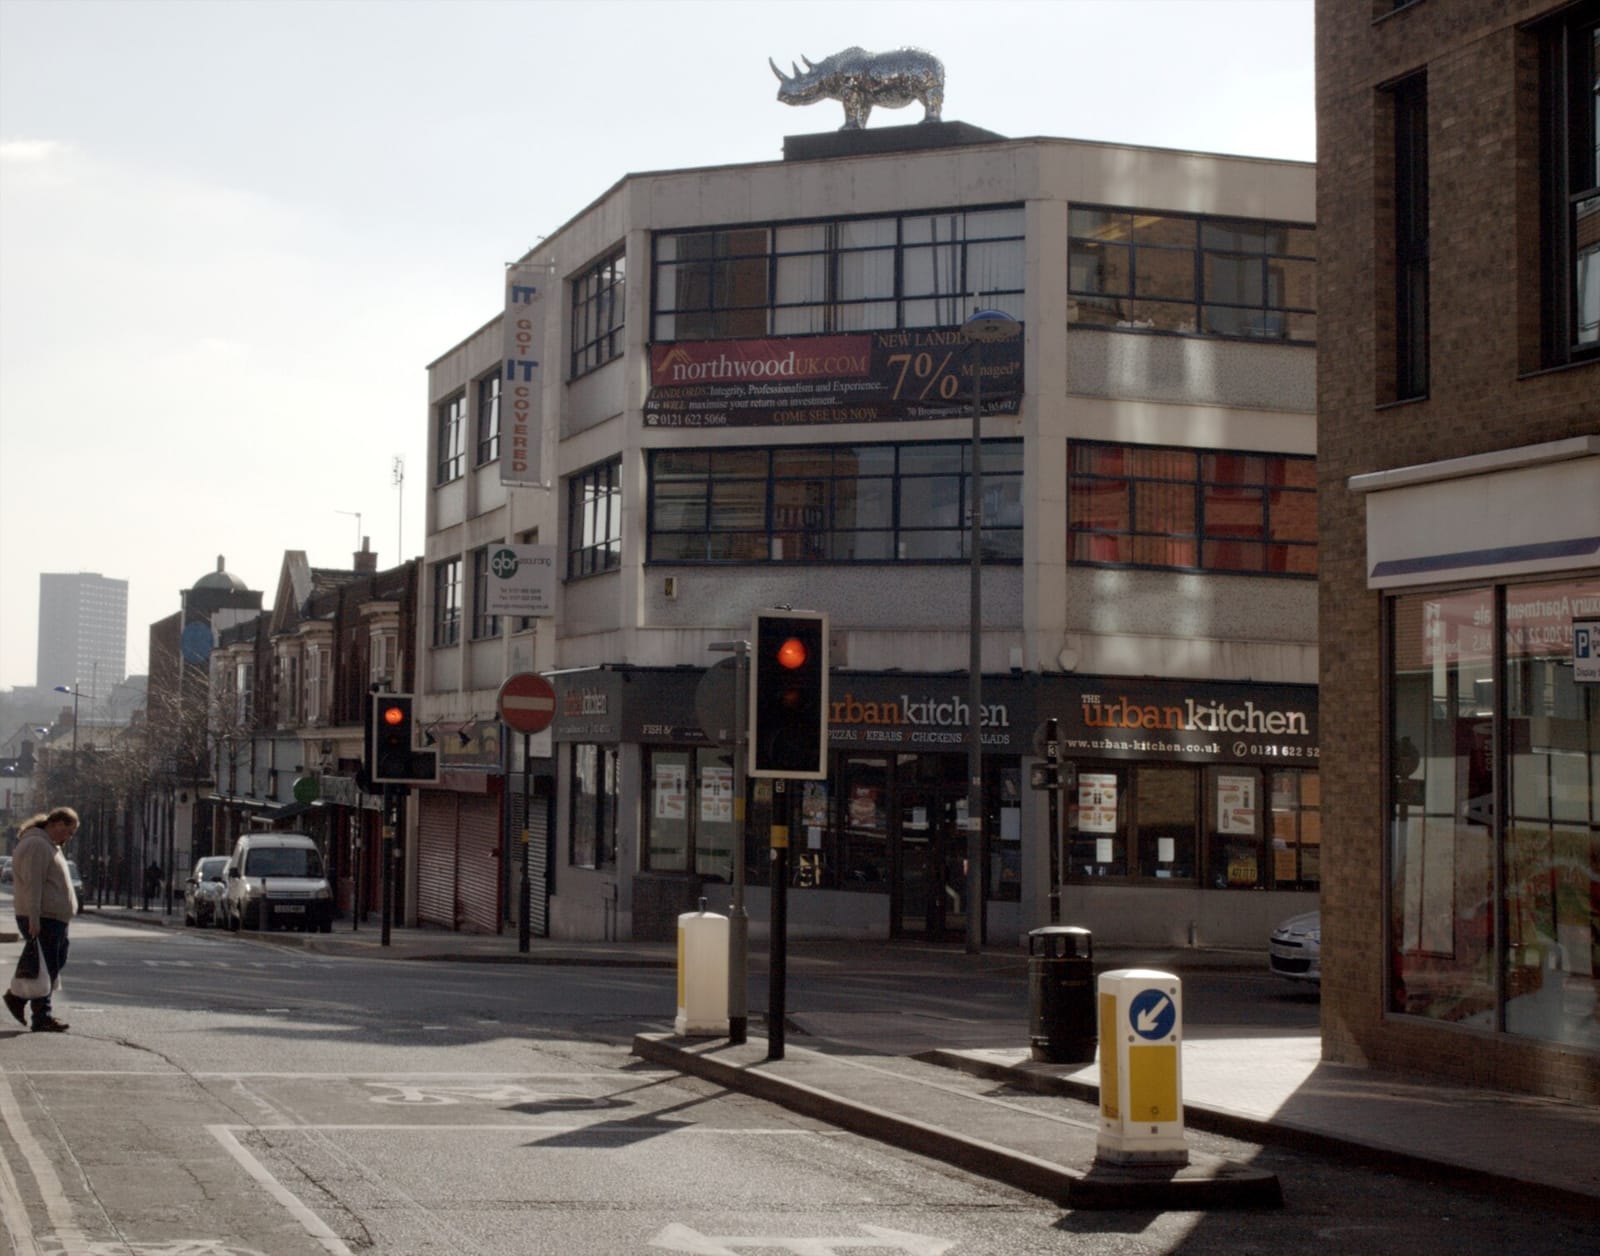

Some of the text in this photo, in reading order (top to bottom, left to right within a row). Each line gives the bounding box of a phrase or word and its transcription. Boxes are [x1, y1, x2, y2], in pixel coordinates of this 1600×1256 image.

[512, 286, 537, 304] IT
[515, 319, 532, 356] GOT
[879, 334, 911, 347] NEW
[507, 359, 539, 382] IT
[886, 350, 959, 400] 7%
[748, 382, 813, 394] Professionalism
[816, 381, 831, 392] and
[729, 399, 749, 411] your
[750, 398, 776, 409] return
[777, 398, 788, 408] on
[660, 411, 727, 425] 0121 622 5066
[773, 407, 878, 423] COME SEE US NOW
[512, 386, 530, 472] COVERED
[1578, 631, 1589, 658] P
[1081, 693, 1101, 704] THE
[827, 693, 1010, 727] rbankitchen
[1081, 695, 1310, 736] urbankitchen
[642, 724, 662, 735] FISH
[865, 730, 904, 742] KEBABS
[911, 731, 962, 744] CHICKENS
[979, 733, 1010, 745] ALADS
[1064, 738, 1222, 754] ww.urban-kitchen.co.uk
[1250, 744, 1279, 757] 0121
[1281, 745, 1303, 758] 622
[776, 781, 784, 792] 5
